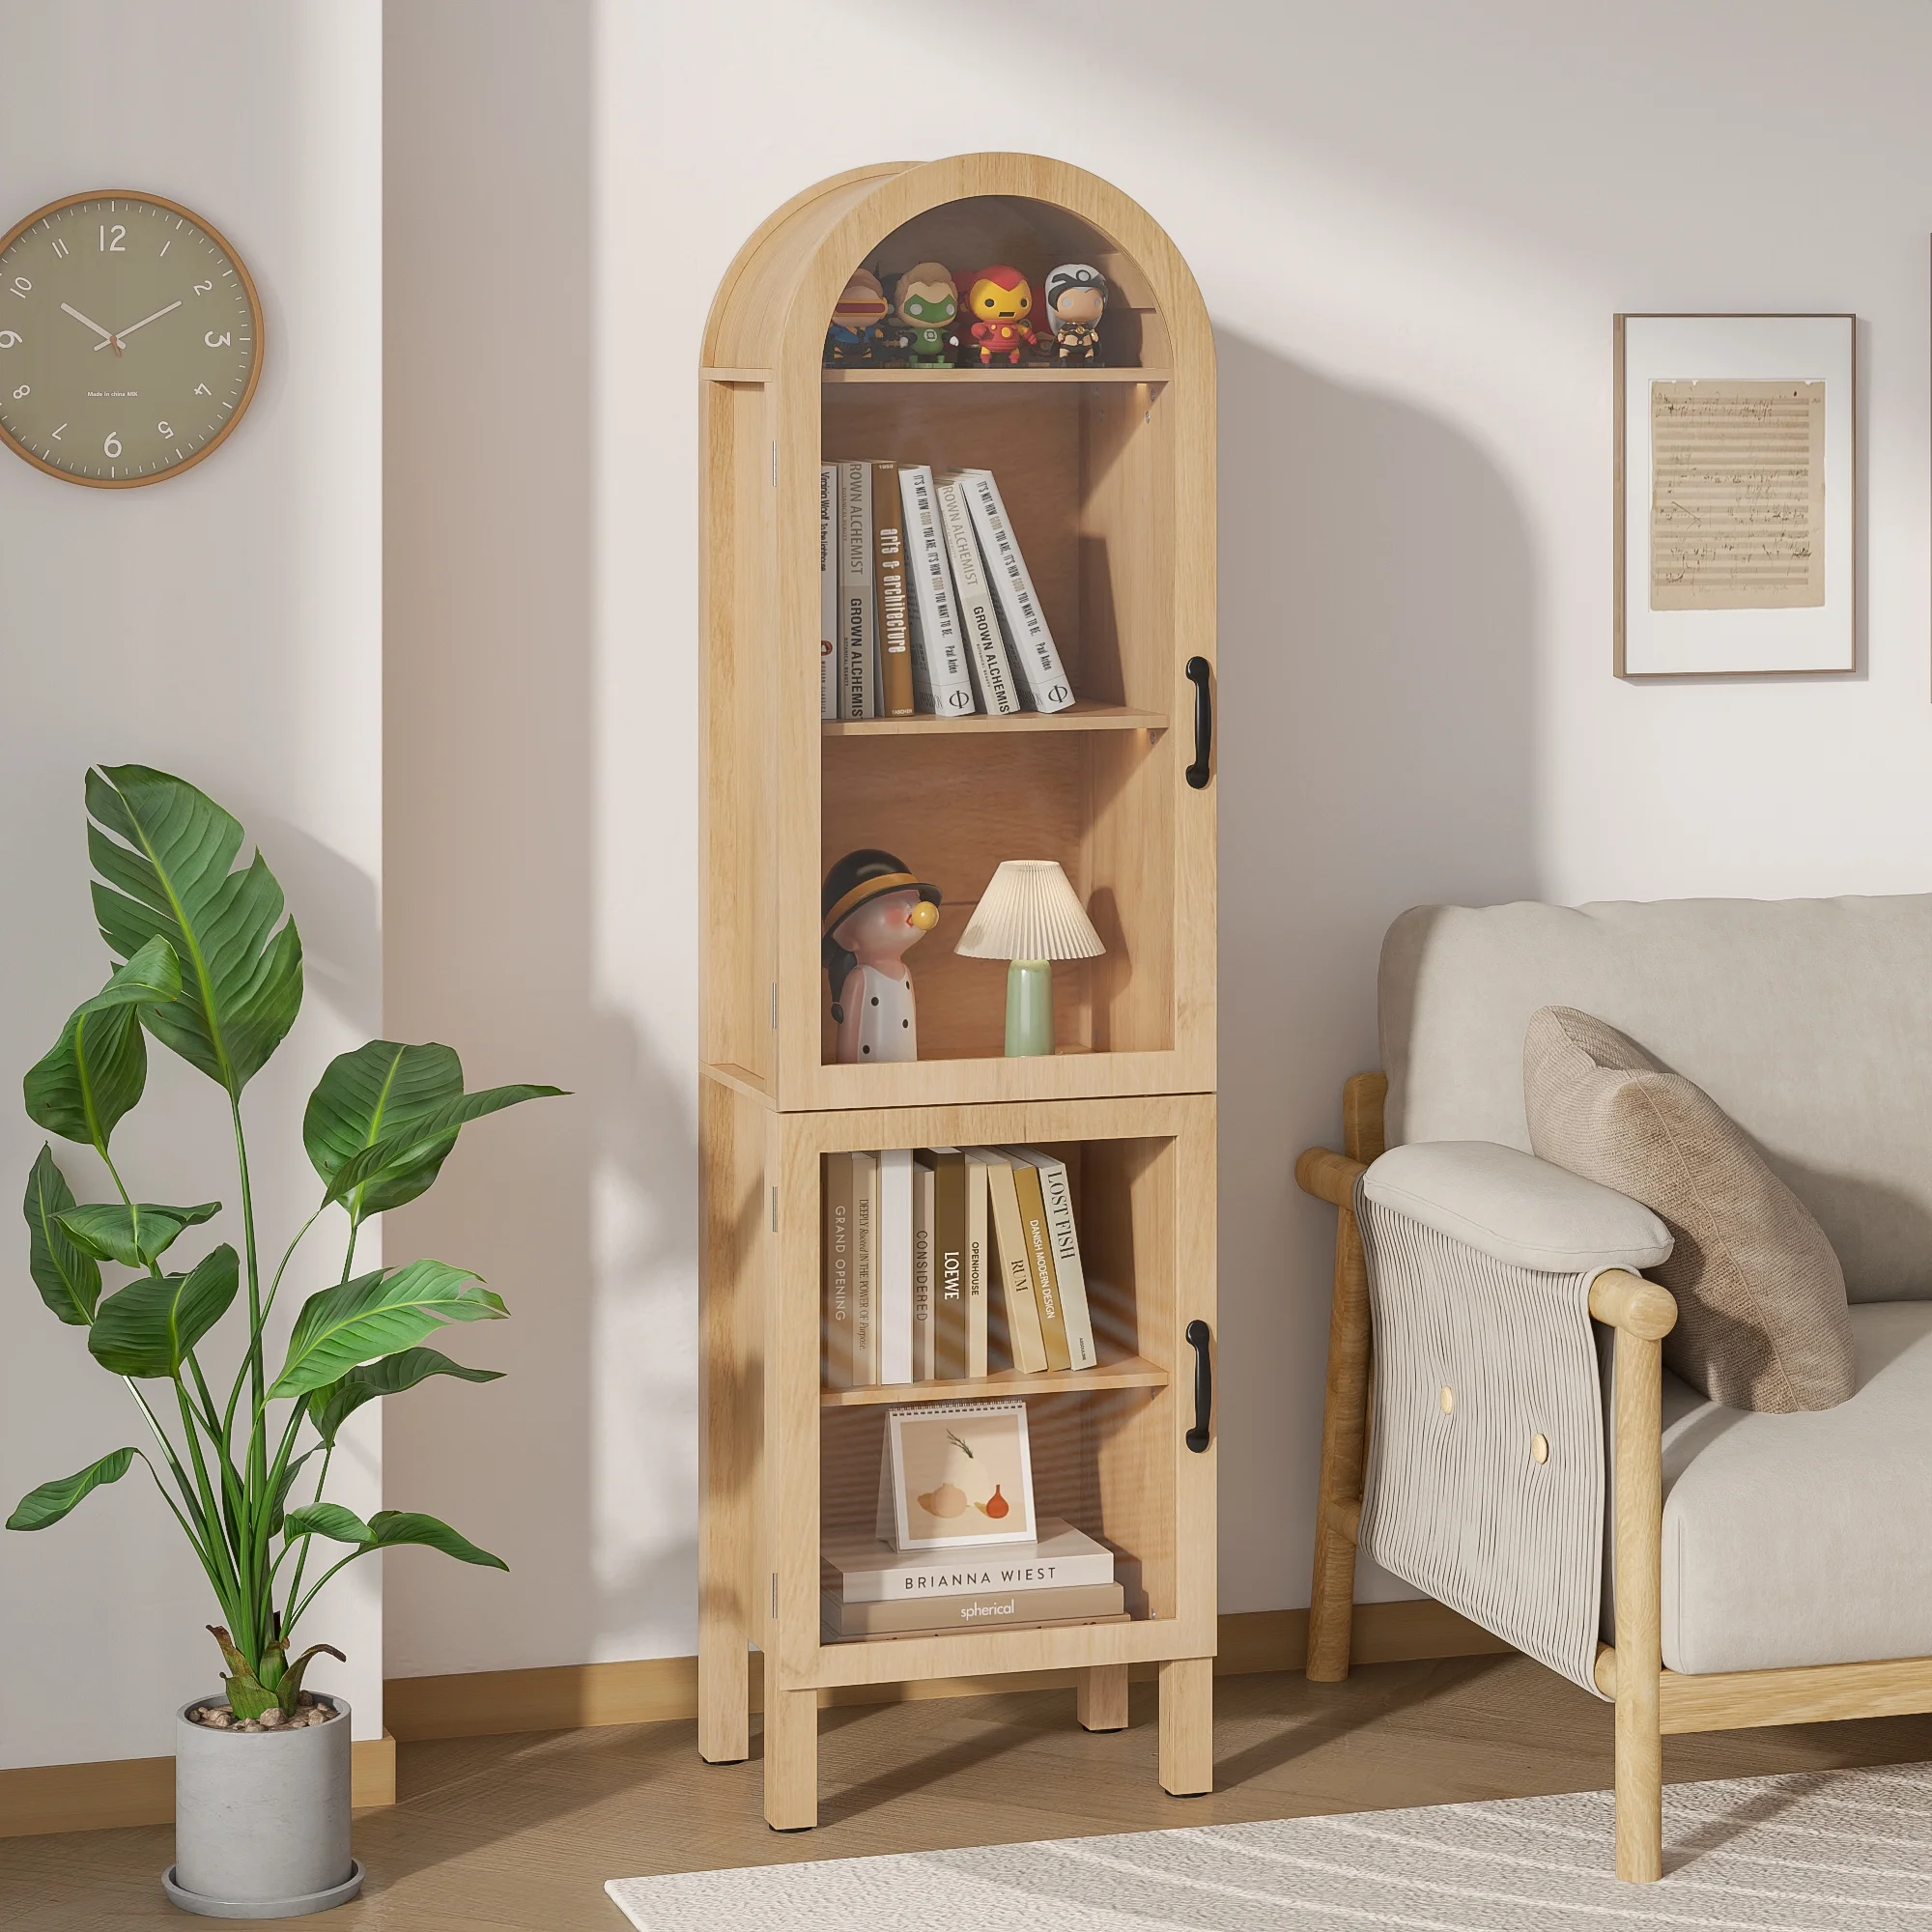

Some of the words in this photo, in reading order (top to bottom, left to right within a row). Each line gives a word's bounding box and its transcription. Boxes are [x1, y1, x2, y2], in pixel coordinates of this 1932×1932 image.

[99, 224, 126, 251] 12
[10, 276, 33, 299] 10
[193, 280, 213, 296] 2
[0, 330, 23, 348] 9
[205, 330, 231, 348] 3
[13, 384, 31, 400] 8
[193, 383, 213, 396] 4
[52, 423, 68, 440] 7
[157, 421, 174, 439] 5
[103, 431, 122, 458] 6
[821, 471, 830, 498] Virginia
[913, 474, 924, 486] IT'S
[977, 481, 988, 493] IT'S
[916, 486, 927, 497] NOT
[980, 492, 993, 503] NOT
[821, 499, 830, 521] Woolf
[918, 498, 929, 510] HOW
[984, 502, 997, 516] HOW
[920, 512, 931, 526] GOOD
[989, 516, 1003, 530] GOOD
[850, 506, 863, 575] ALCHEMIST
[880, 527, 900, 554] arts
[923, 526, 935, 538] YOU
[995, 529, 1008, 542] YOU
[927, 553, 939, 563] IT'S
[952, 524, 978, 585] ALCHEMIST
[1004, 554, 1015, 566] IT'S
[930, 563, 941, 576] HOW
[1008, 564, 1020, 578] HOW
[935, 592, 947, 603] YOU
[1017, 591, 1030, 604] YOU
[883, 576, 906, 653] architecture
[938, 604, 950, 618] WANT
[1021, 603, 1036, 618] WANT
[851, 598, 862, 647] GROWN
[1027, 618, 1037, 627] TO
[945, 645, 956, 660] Paul
[1036, 641, 1047, 655] Paul
[948, 658, 959, 674] Arden
[974, 606, 993, 650] GROWN
[985, 654, 1010, 713] ALCHEMIS
[1039, 654, 1052, 671] Arden
[851, 651, 863, 718] ALCHEMIS
[1047, 1171, 1069, 1219] LOST
[860, 1199, 868, 1227] DEEPLY
[836, 1206, 846, 1253] GRAND
[1030, 1219, 1041, 1251] DANISH
[860, 1228, 868, 1253] Rooted
[1055, 1221, 1076, 1260] FISH
[860, 1253, 868, 1262] IN
[860, 1263, 868, 1278] THE
[916, 1231, 927, 1321] CONSIDERED
[944, 1252, 959, 1300] LOEWE
[1011, 1259, 1028, 1293] RUM
[1036, 1252, 1048, 1290] MODERN
[836, 1260, 846, 1321] OPENING
[860, 1281, 868, 1309] POWER
[1040, 1289, 1055, 1320] DESIGN
[860, 1310, 868, 1321] OF
[905, 1572, 991, 1589] BRIANNA
[1001, 1567, 1056, 1582] WIEST
[960, 1599, 1014, 1621] spherical
